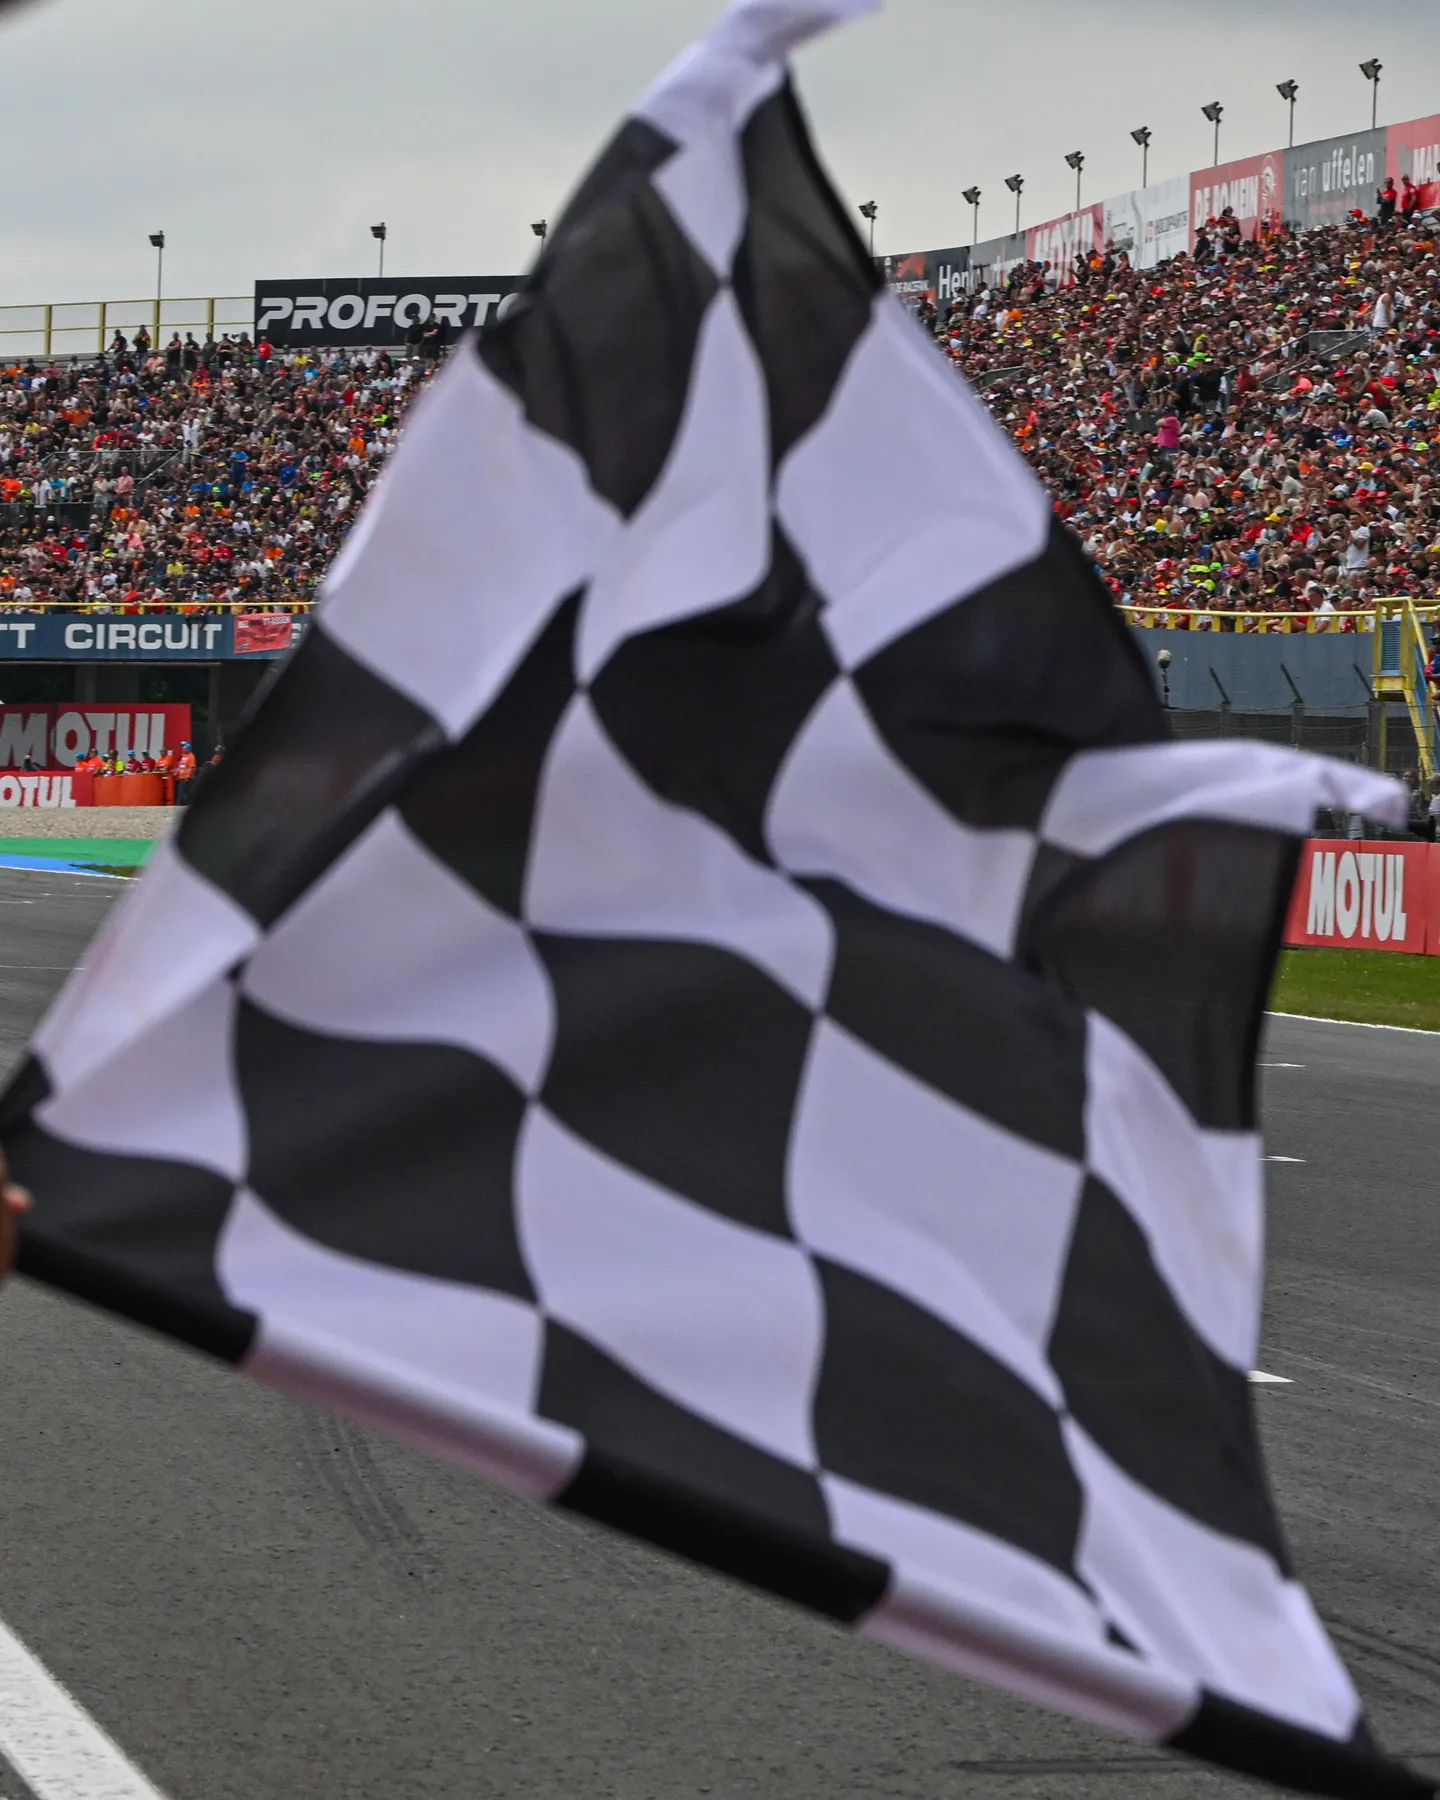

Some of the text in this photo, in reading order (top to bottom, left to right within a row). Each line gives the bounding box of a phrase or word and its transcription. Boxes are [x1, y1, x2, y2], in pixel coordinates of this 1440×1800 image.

[1322, 145, 1375, 192] uffelen
[0, 623, 35, 649] T
[64, 623, 222, 650] CIRCUIT
[0, 711, 166, 768] MOTUL
[0, 775, 76, 809] OTUL
[1306, 851, 1407, 941] MOTUL
